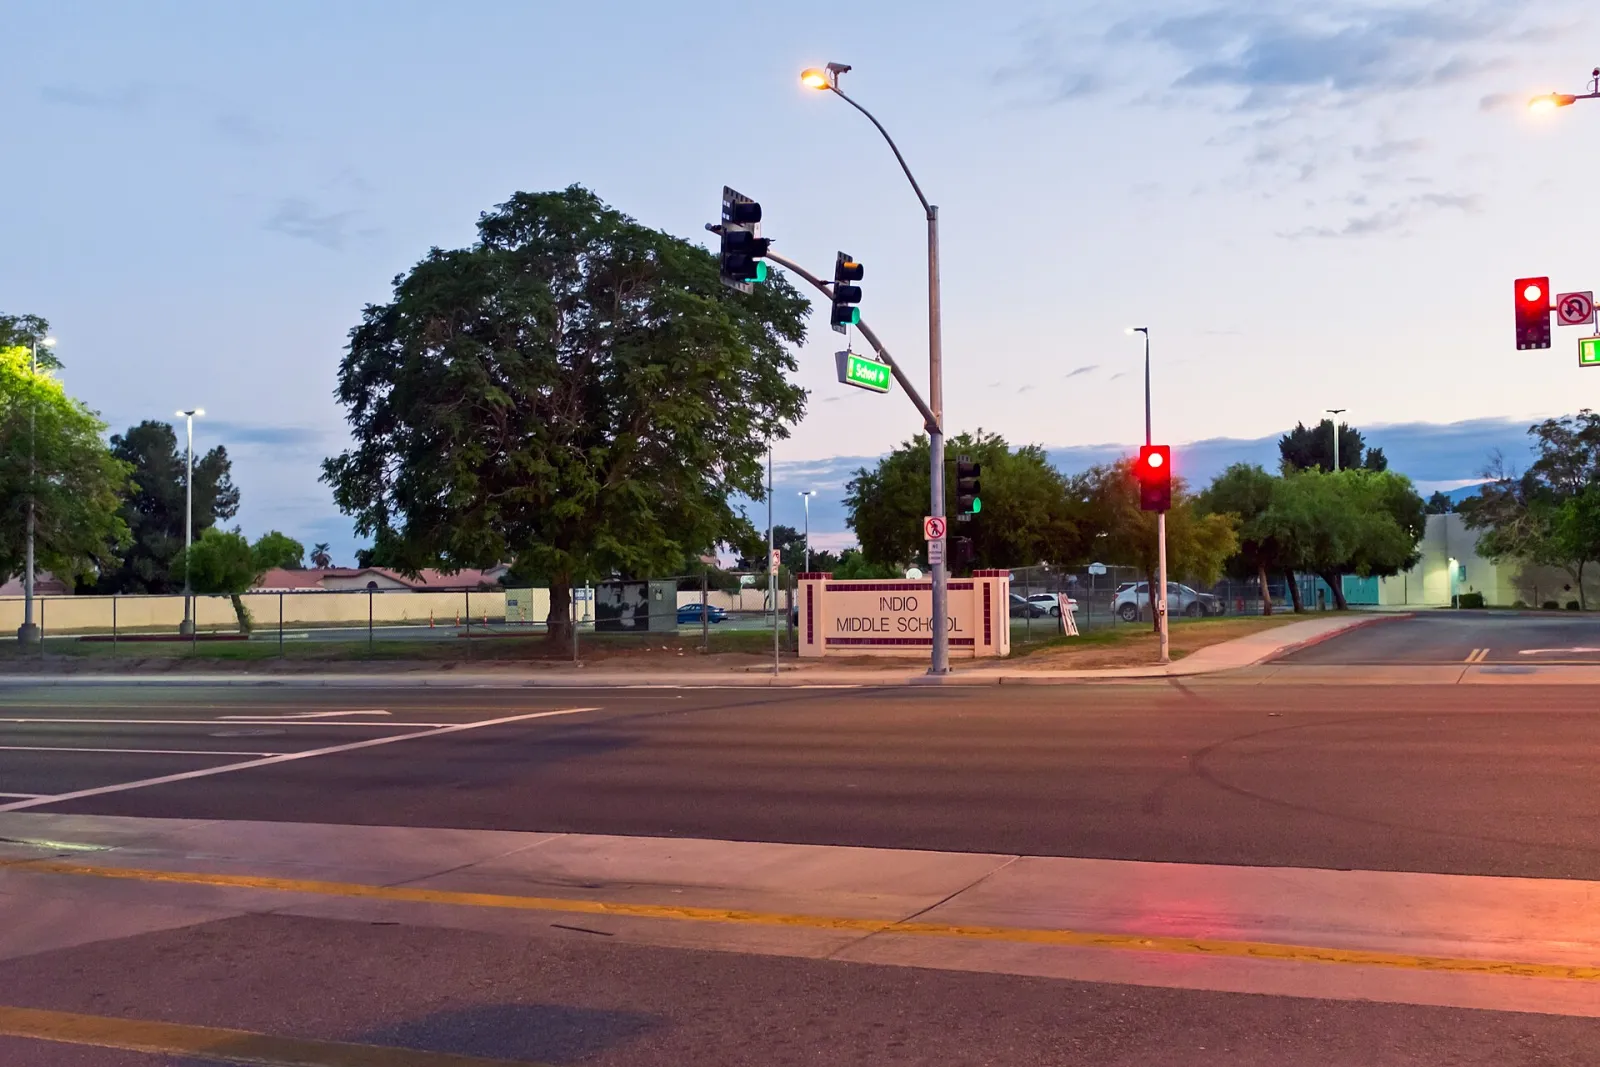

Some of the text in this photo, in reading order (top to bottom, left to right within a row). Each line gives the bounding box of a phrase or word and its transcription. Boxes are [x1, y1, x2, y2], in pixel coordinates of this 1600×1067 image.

[856, 364, 877, 382] School
[879, 596, 918, 612] INDIO
[836, 617, 890, 632] MIDDLE
